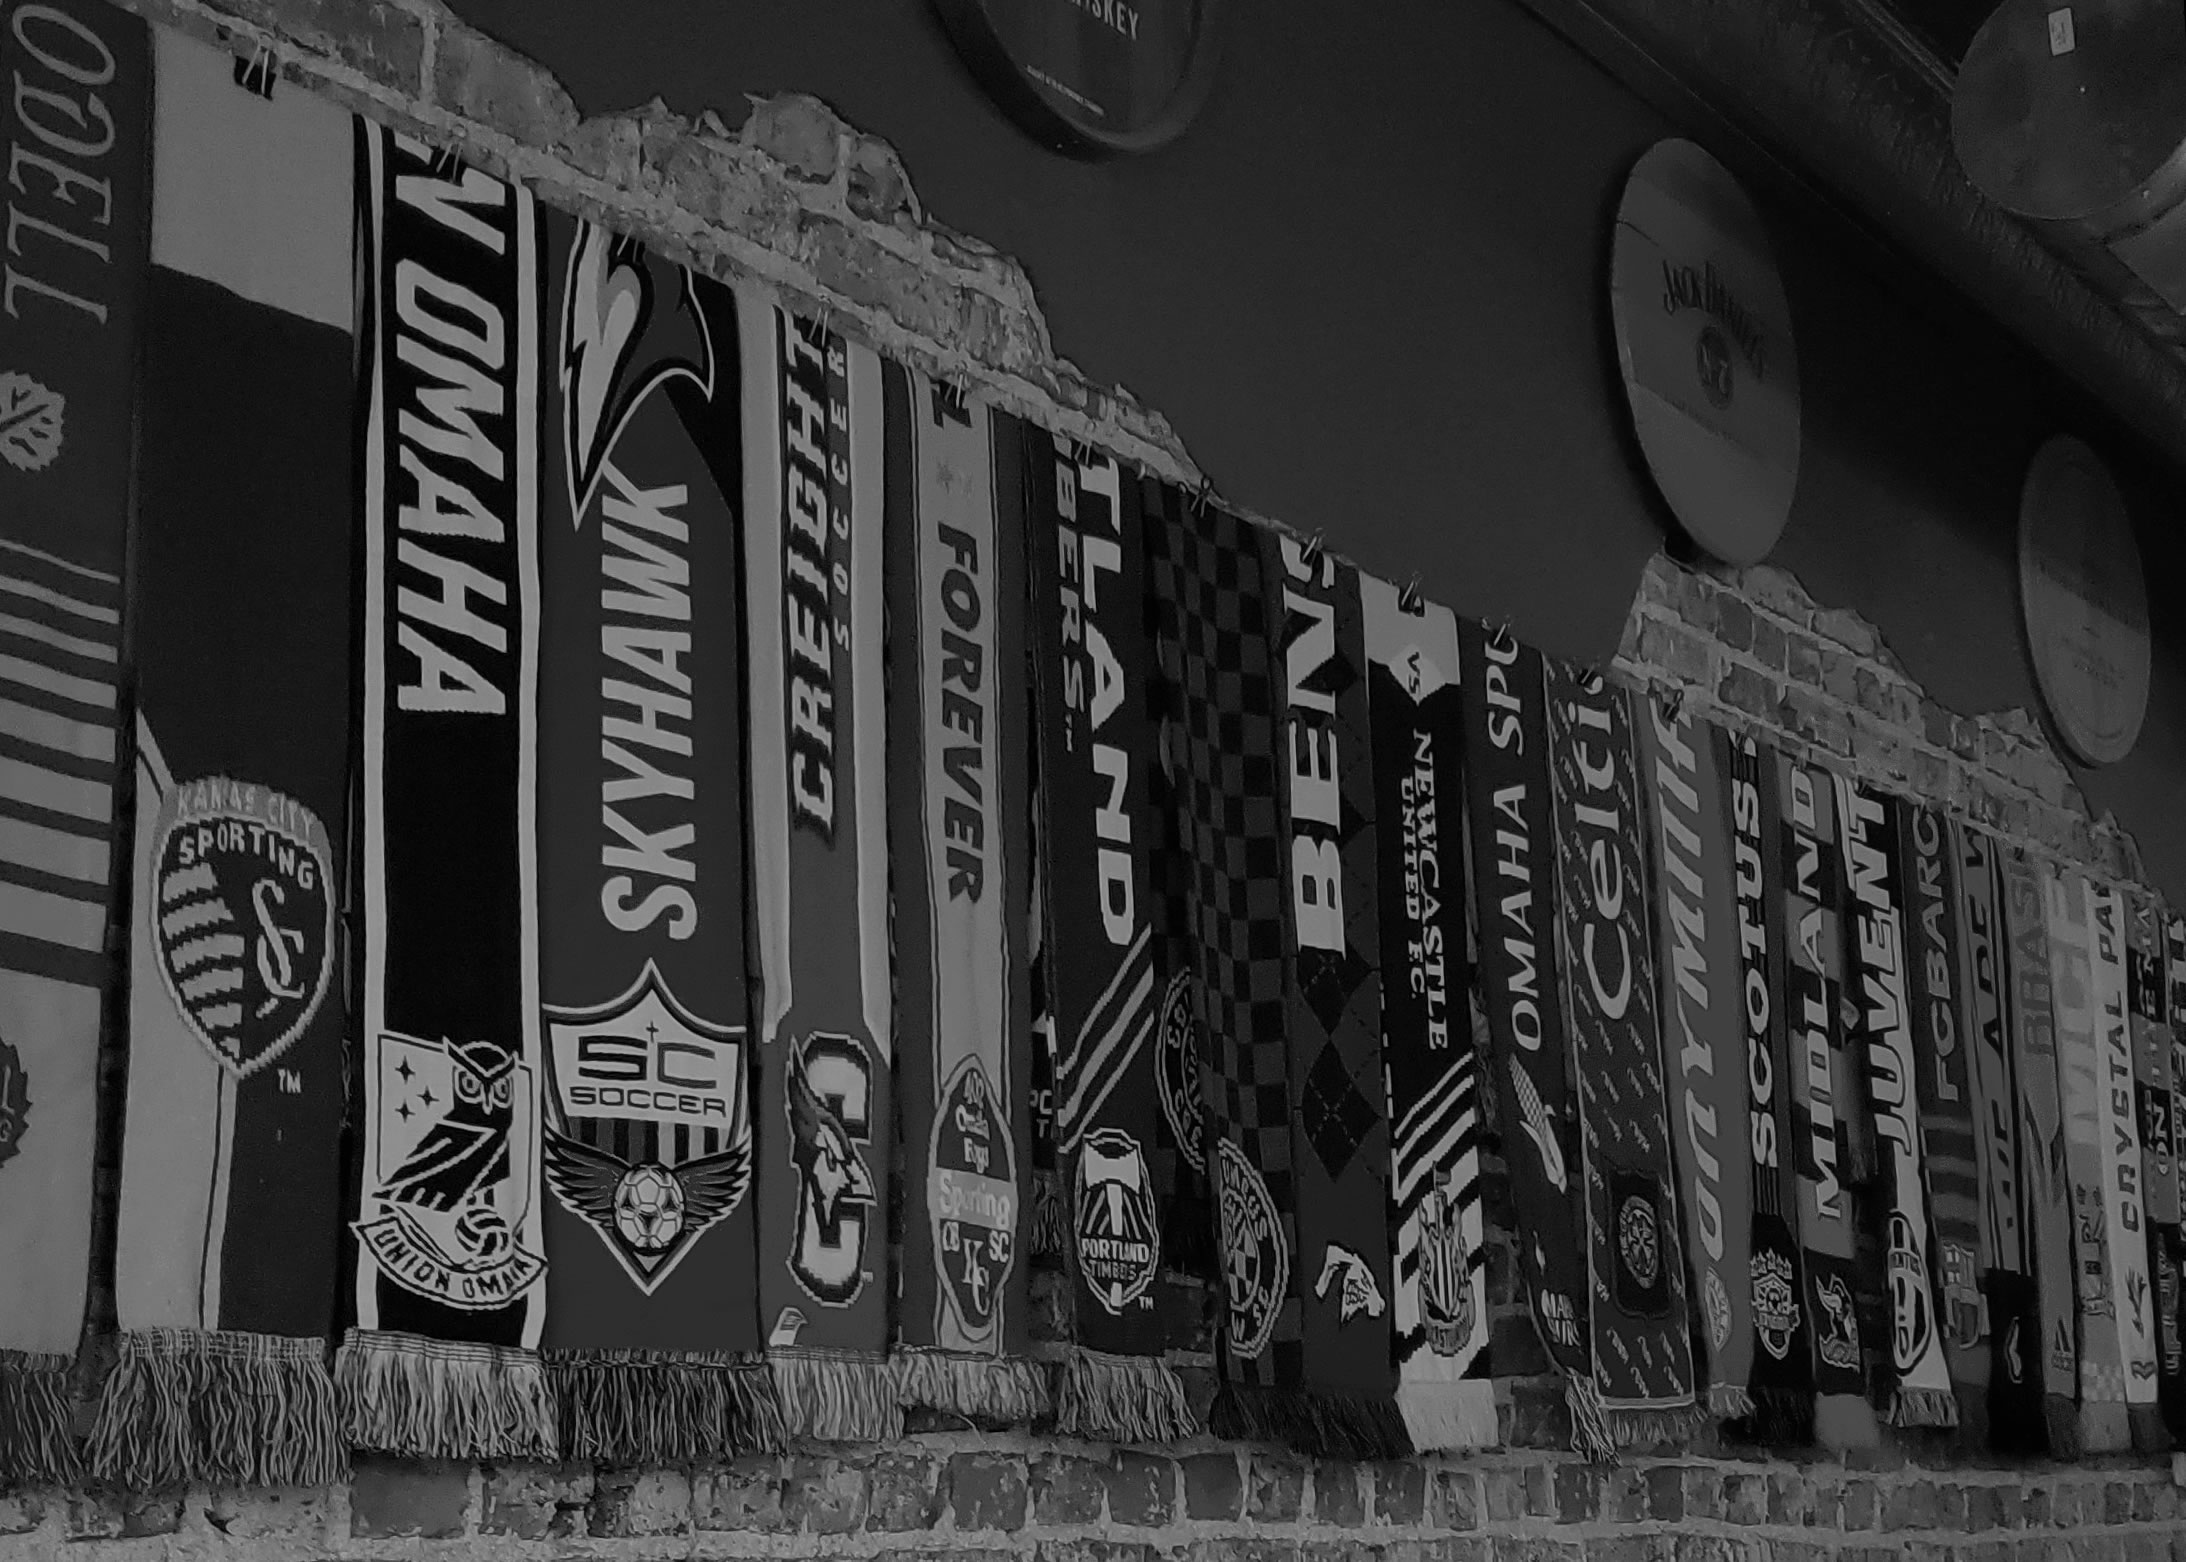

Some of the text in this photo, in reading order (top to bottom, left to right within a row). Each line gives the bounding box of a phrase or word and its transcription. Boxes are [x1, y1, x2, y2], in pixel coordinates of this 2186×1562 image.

[3, 3, 117, 326] ODELL
[394, 258, 507, 714] OMAHA
[826, 338, 850, 652] SOCCER
[600, 452, 698, 941] SKYHAWK
[937, 520, 986, 903] FOREVER
[1401, 775, 1422, 921] UNITED
[179, 820, 314, 890] SPORTING
[1412, 727, 1450, 1050] NEWCASTLE
[1497, 784, 1543, 1053] OMAHA
[1731, 775, 1780, 1168] SCOTUS
[1788, 762, 1843, 1221] MIDLAND
[277, 1066, 302, 1095] TM
[570, 1085, 727, 1119] SOCCER
[2104, 990, 2140, 1235] CRYSTAL
[373, 1229, 451, 1293] UNION
